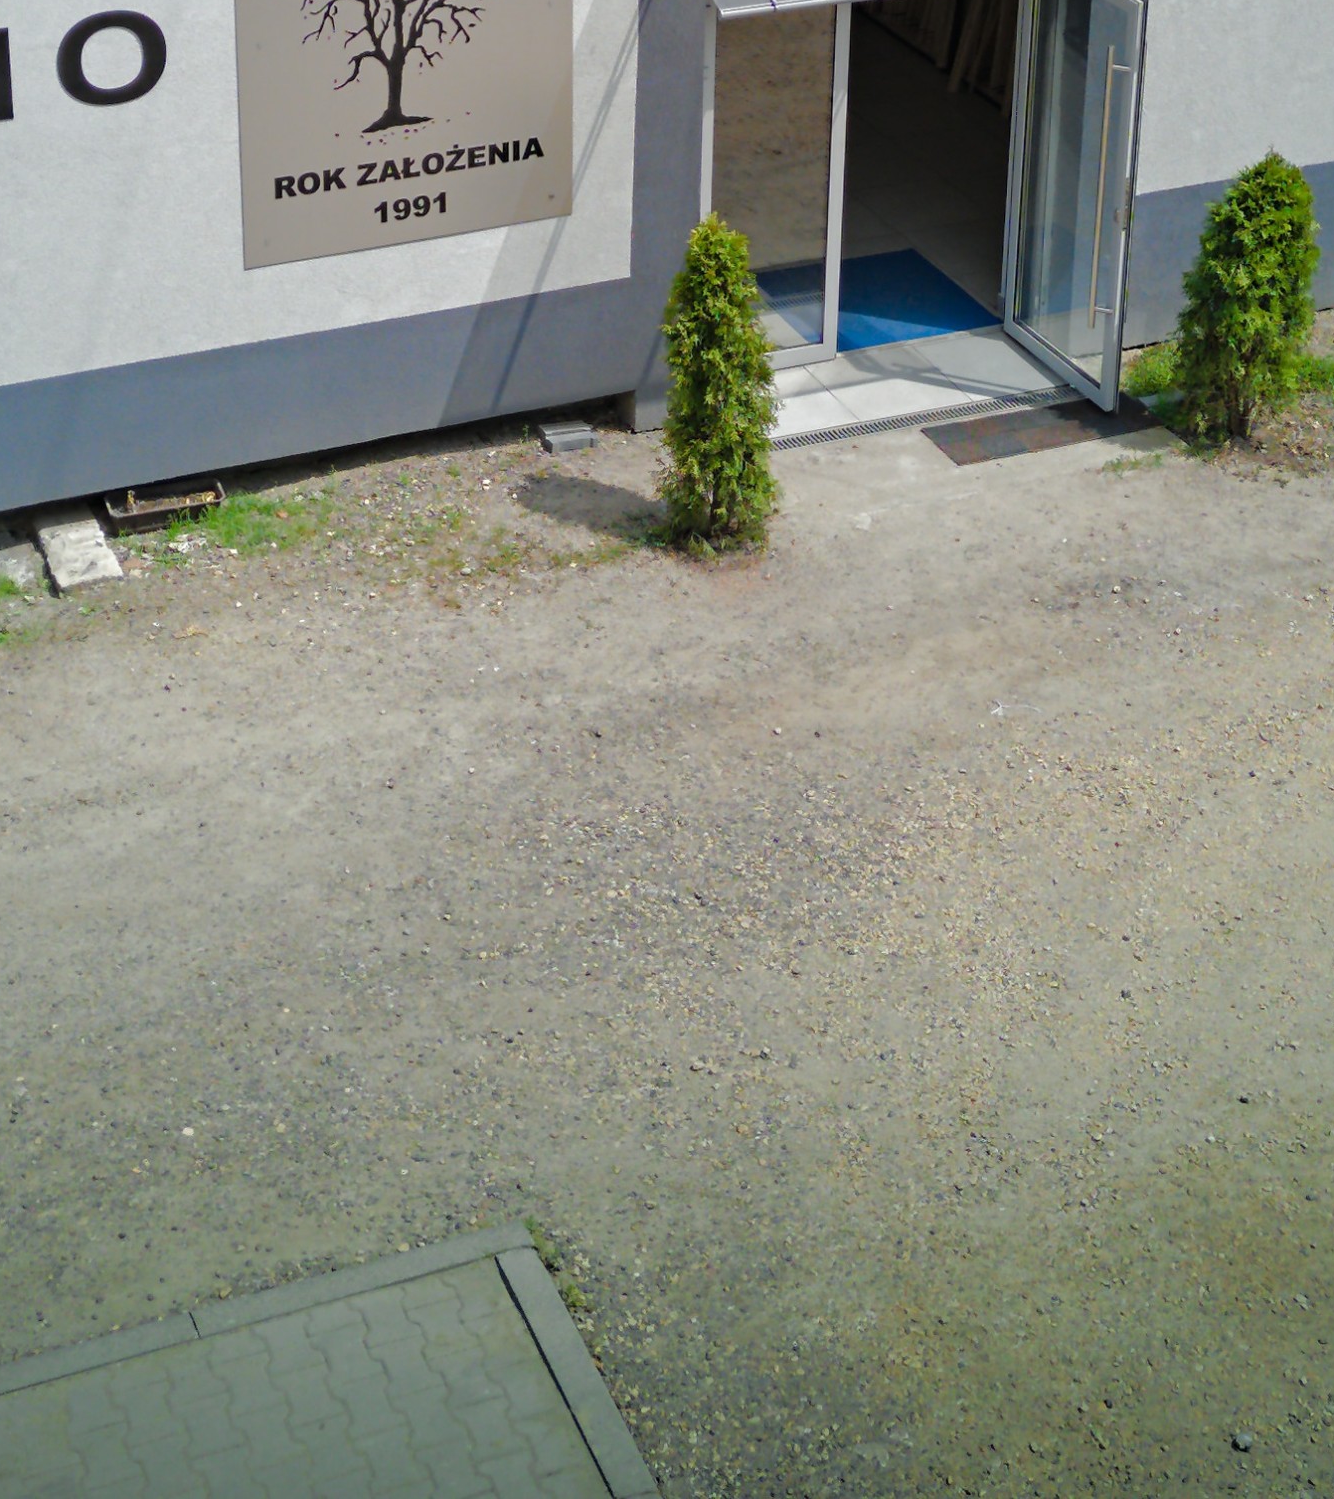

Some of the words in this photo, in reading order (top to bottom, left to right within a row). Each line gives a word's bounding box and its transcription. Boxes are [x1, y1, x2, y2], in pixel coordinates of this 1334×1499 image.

[274, 166, 347, 200] ROK
[356, 137, 546, 187] ZAŁOŻENIA
[373, 191, 448, 224] 1991
